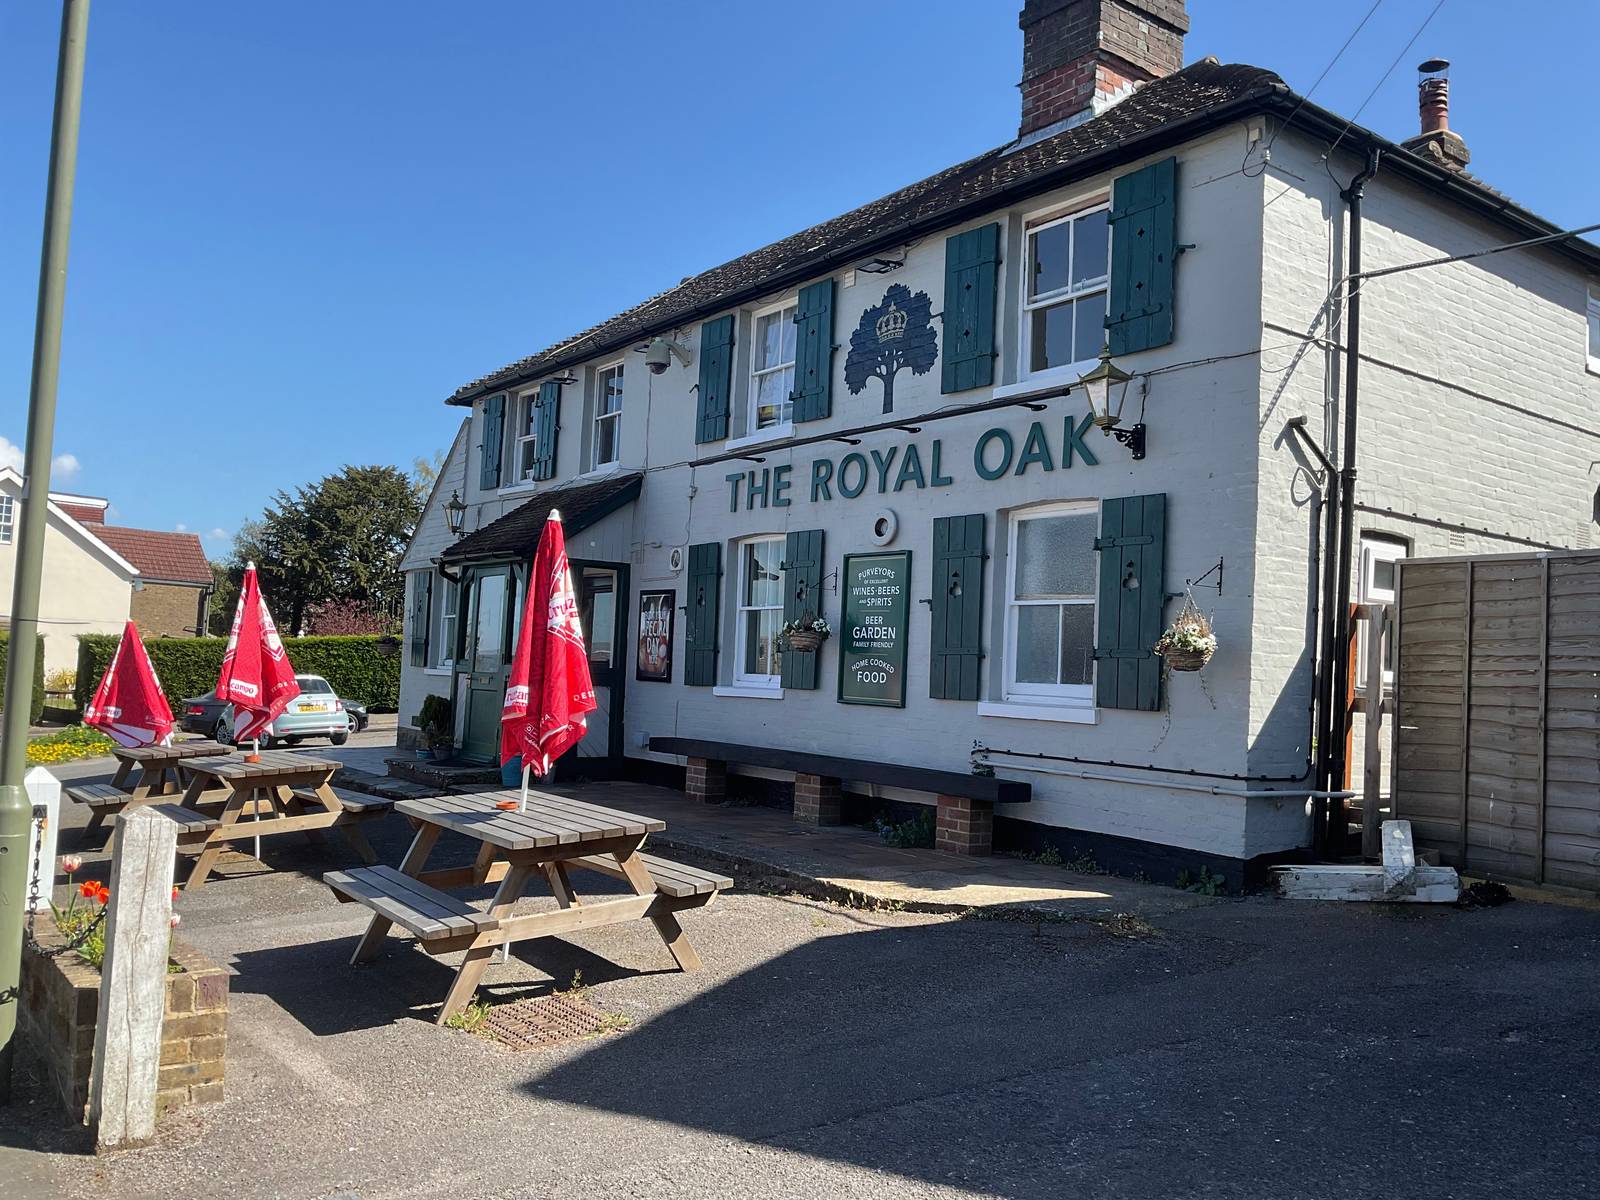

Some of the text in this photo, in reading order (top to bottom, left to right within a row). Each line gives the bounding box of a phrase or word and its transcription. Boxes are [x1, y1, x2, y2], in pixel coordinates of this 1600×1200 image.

[725, 412, 1099, 513] THE ROYAL OAK
[858, 567, 895, 580] PURVEYORS
[853, 586, 900, 595] WINES BEERS
[866, 597, 892, 606] SPIRITS
[865, 616, 883, 624] BEER
[852, 626, 896, 639] GARDEN
[646, 637, 660, 654] DAY
[851, 658, 895, 674] HOME COOKED
[857, 671, 887, 683] FOOD
